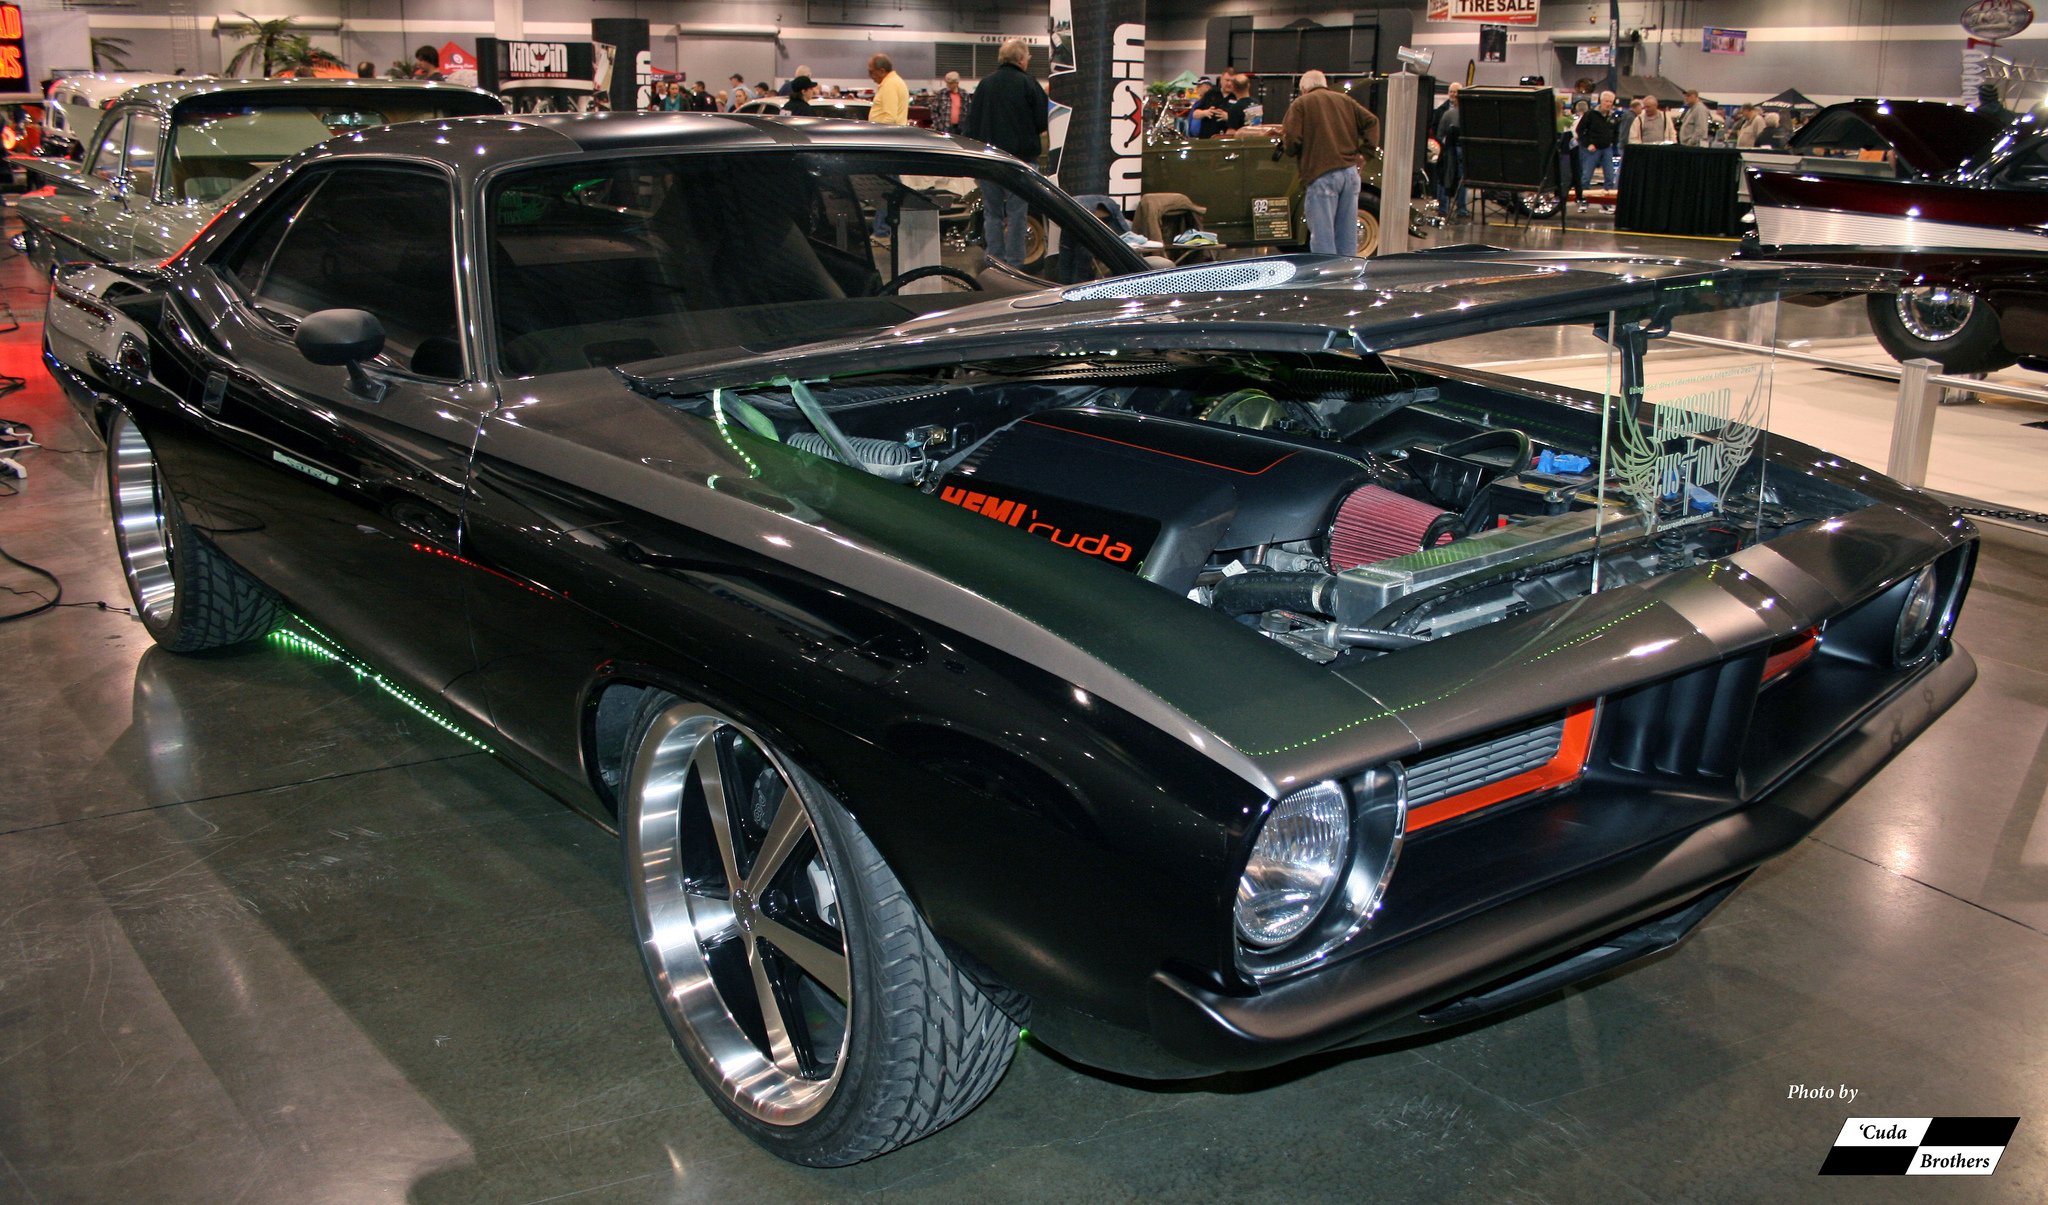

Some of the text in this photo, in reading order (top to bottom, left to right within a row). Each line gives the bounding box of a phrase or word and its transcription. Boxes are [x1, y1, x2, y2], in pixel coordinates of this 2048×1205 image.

[1496, 0, 1535, 12] SALE
[1653, 439, 1723, 515] CUSTOMS
[940, 486, 1028, 528] HEMI
